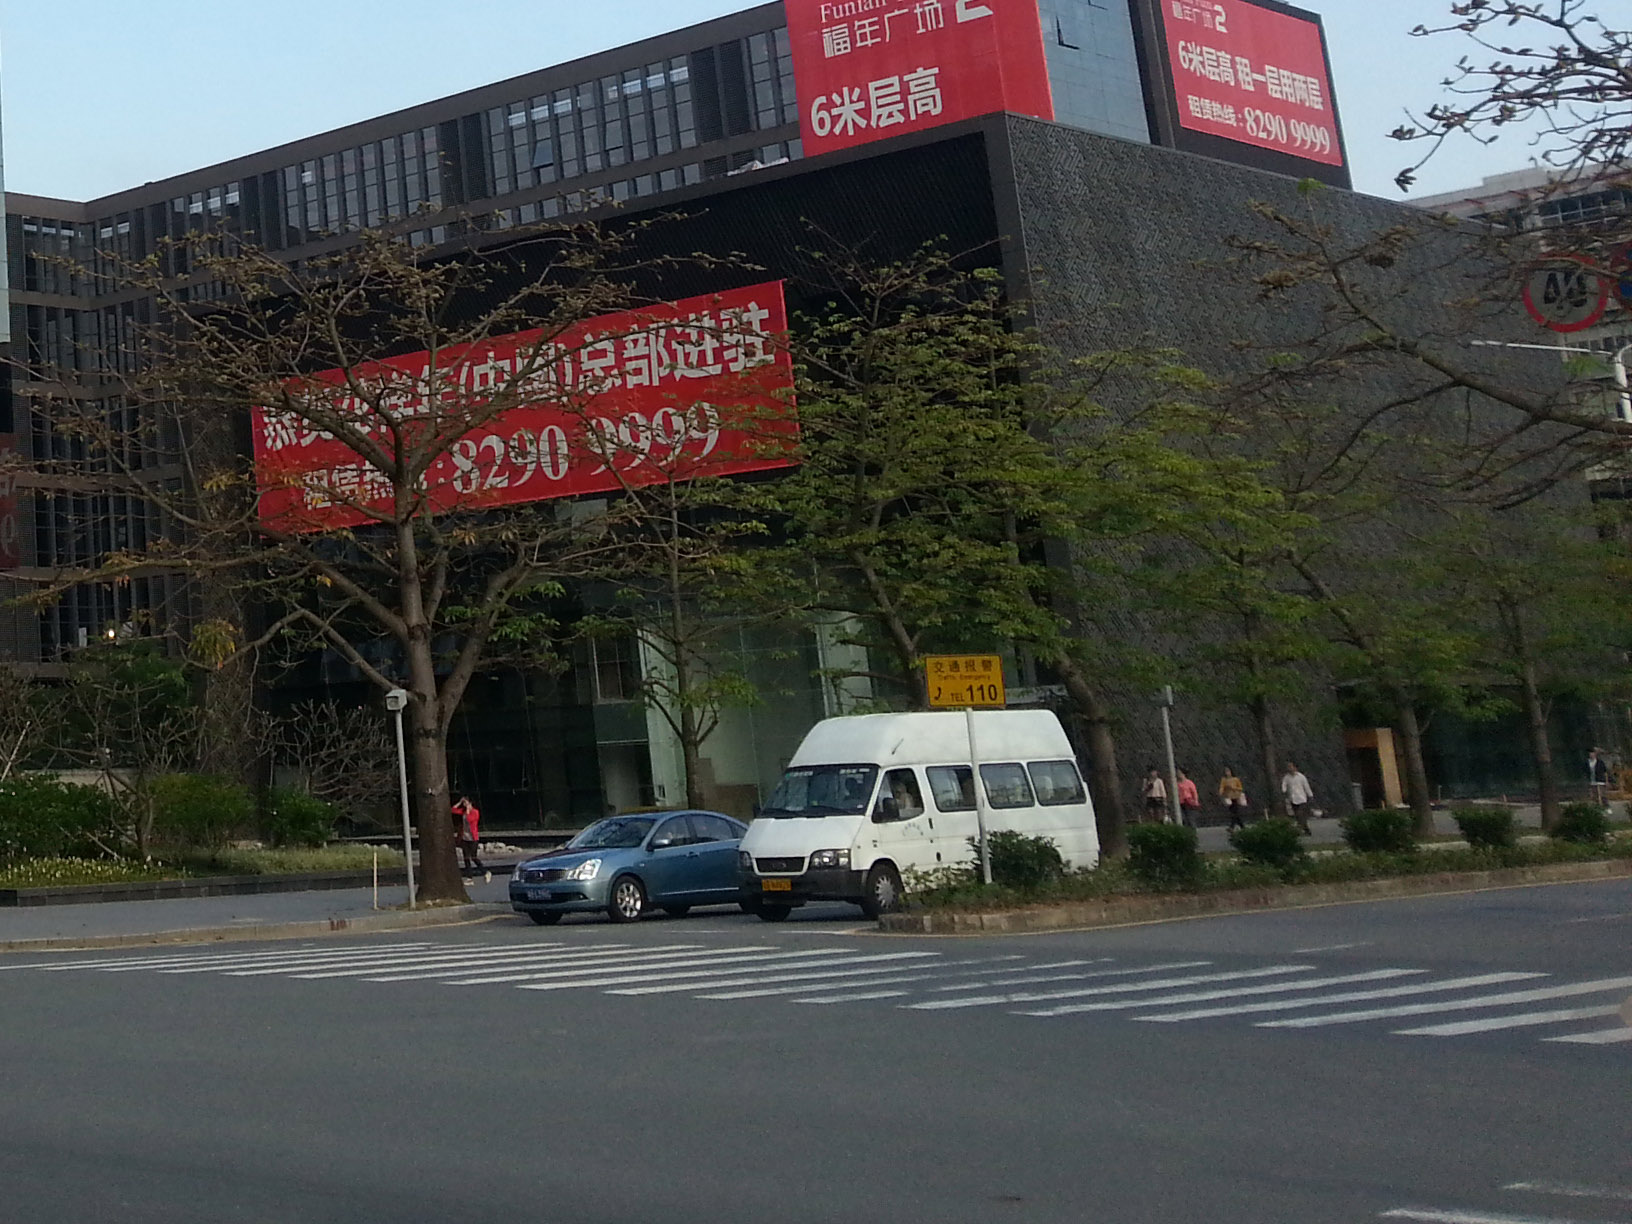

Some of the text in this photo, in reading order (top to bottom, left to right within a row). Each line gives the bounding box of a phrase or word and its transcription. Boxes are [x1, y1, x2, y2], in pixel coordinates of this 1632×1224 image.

[1213, 4, 1228, 33] 2
[1178, 40, 1324, 110] 6米层高 租一层用两层
[811, 67, 943, 137] 6米层高
[1244, 106, 1288, 145] 8290
[1290, 118, 1331, 155] 9999
[451, 424, 569, 494] 8290
[585, 400, 720, 475] 9999
[934, 659, 993, 674] 交通报警
[950, 684, 997, 702] TEL 110
